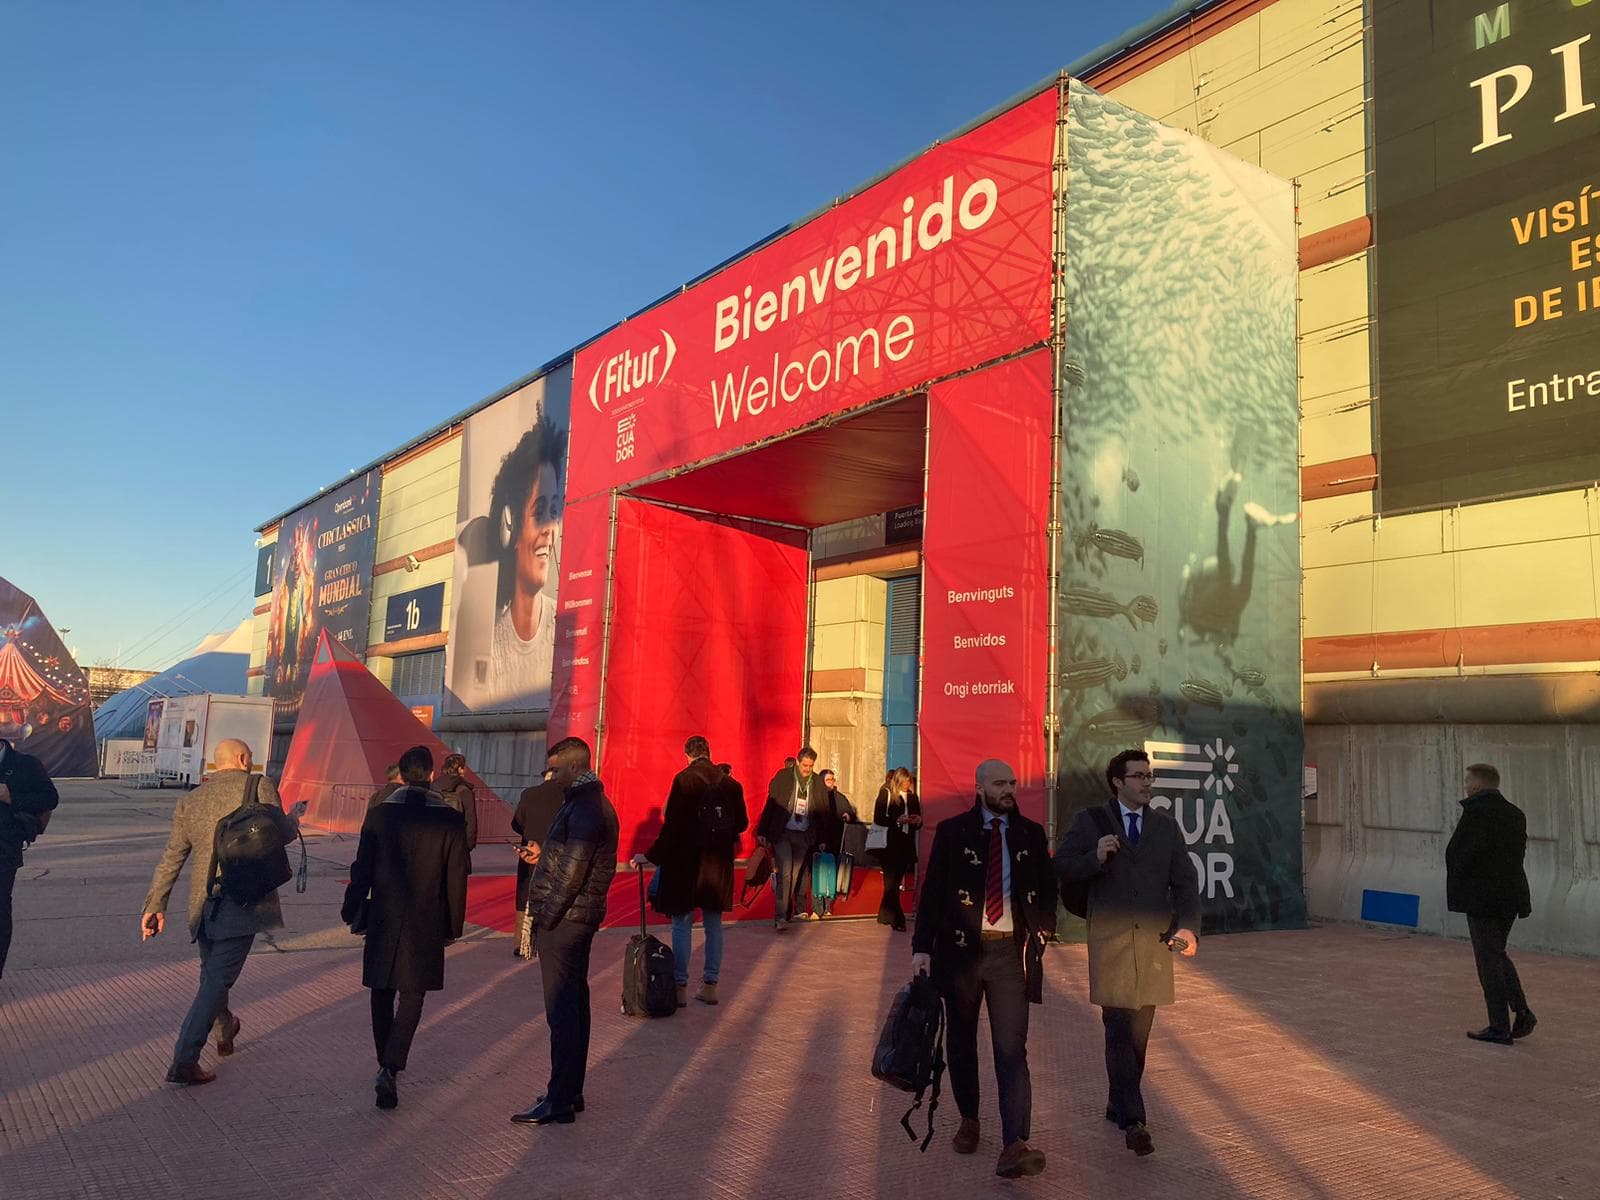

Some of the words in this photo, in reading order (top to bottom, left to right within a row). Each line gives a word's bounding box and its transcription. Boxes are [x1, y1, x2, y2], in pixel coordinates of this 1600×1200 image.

[714, 175, 998, 353] Bienvenido
[1571, 236, 1600, 271] E
[1514, 287, 1563, 328] DE
[711, 315, 915, 429] Welcome
[615, 445, 635, 463] DOR
[616, 430, 635, 449] CUA
[318, 513, 371, 549] CIRCLASSICA
[319, 574, 363, 607] MUNDIAL
[947, 585, 1014, 604] Benvinguts
[406, 599, 420, 630] 1b
[954, 632, 1006, 649] Benvidos
[944, 681, 969, 699] Ongi
[971, 680, 1015, 695] etorriak
